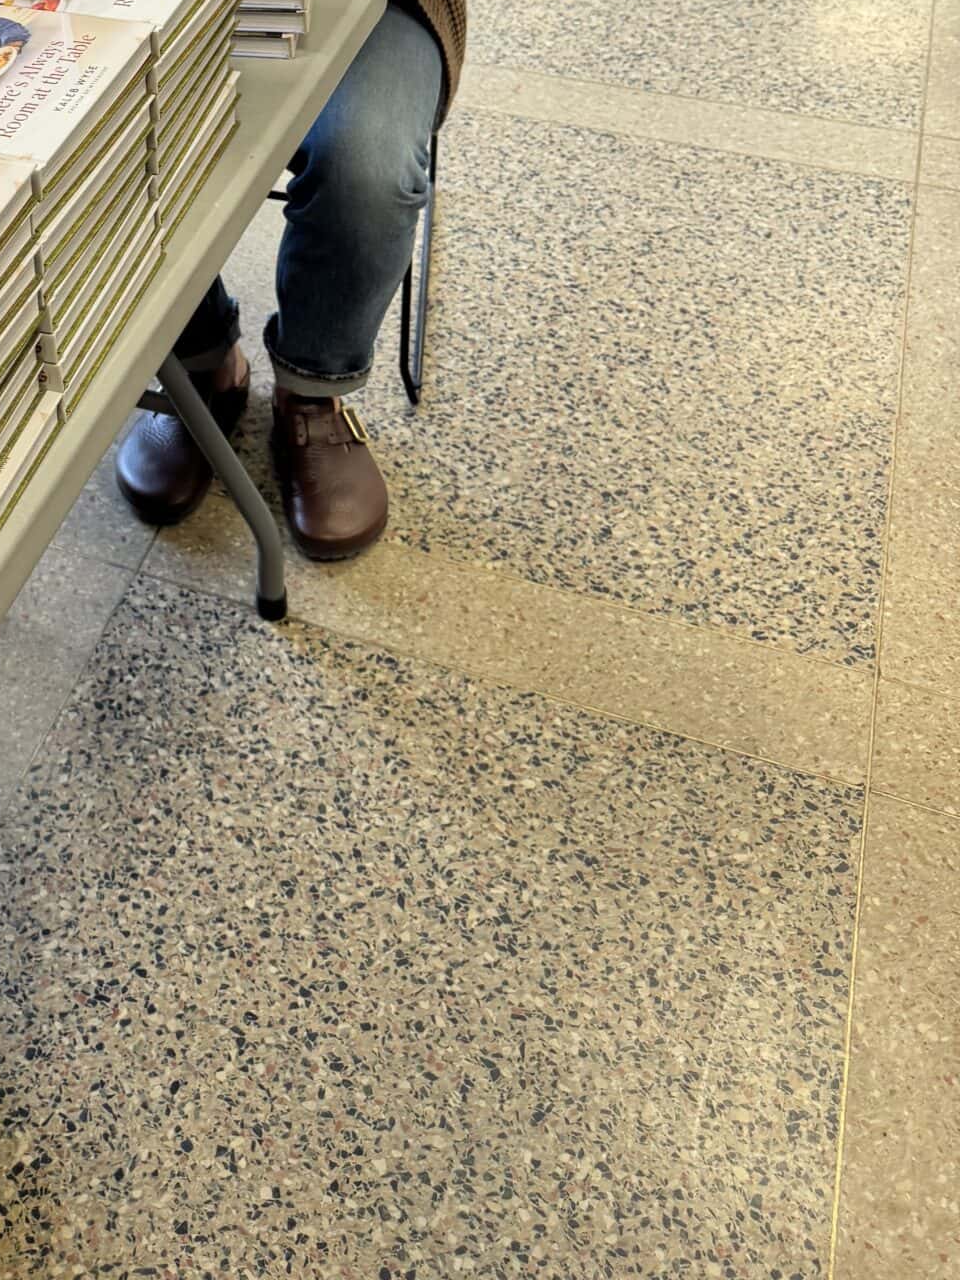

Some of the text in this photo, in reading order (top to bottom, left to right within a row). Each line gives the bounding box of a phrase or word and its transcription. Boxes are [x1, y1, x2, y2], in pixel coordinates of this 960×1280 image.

[19, 40, 65, 80] Always
[32, 88, 52, 100] at
[42, 66, 70, 86] the
[56, 33, 97, 64] Table
